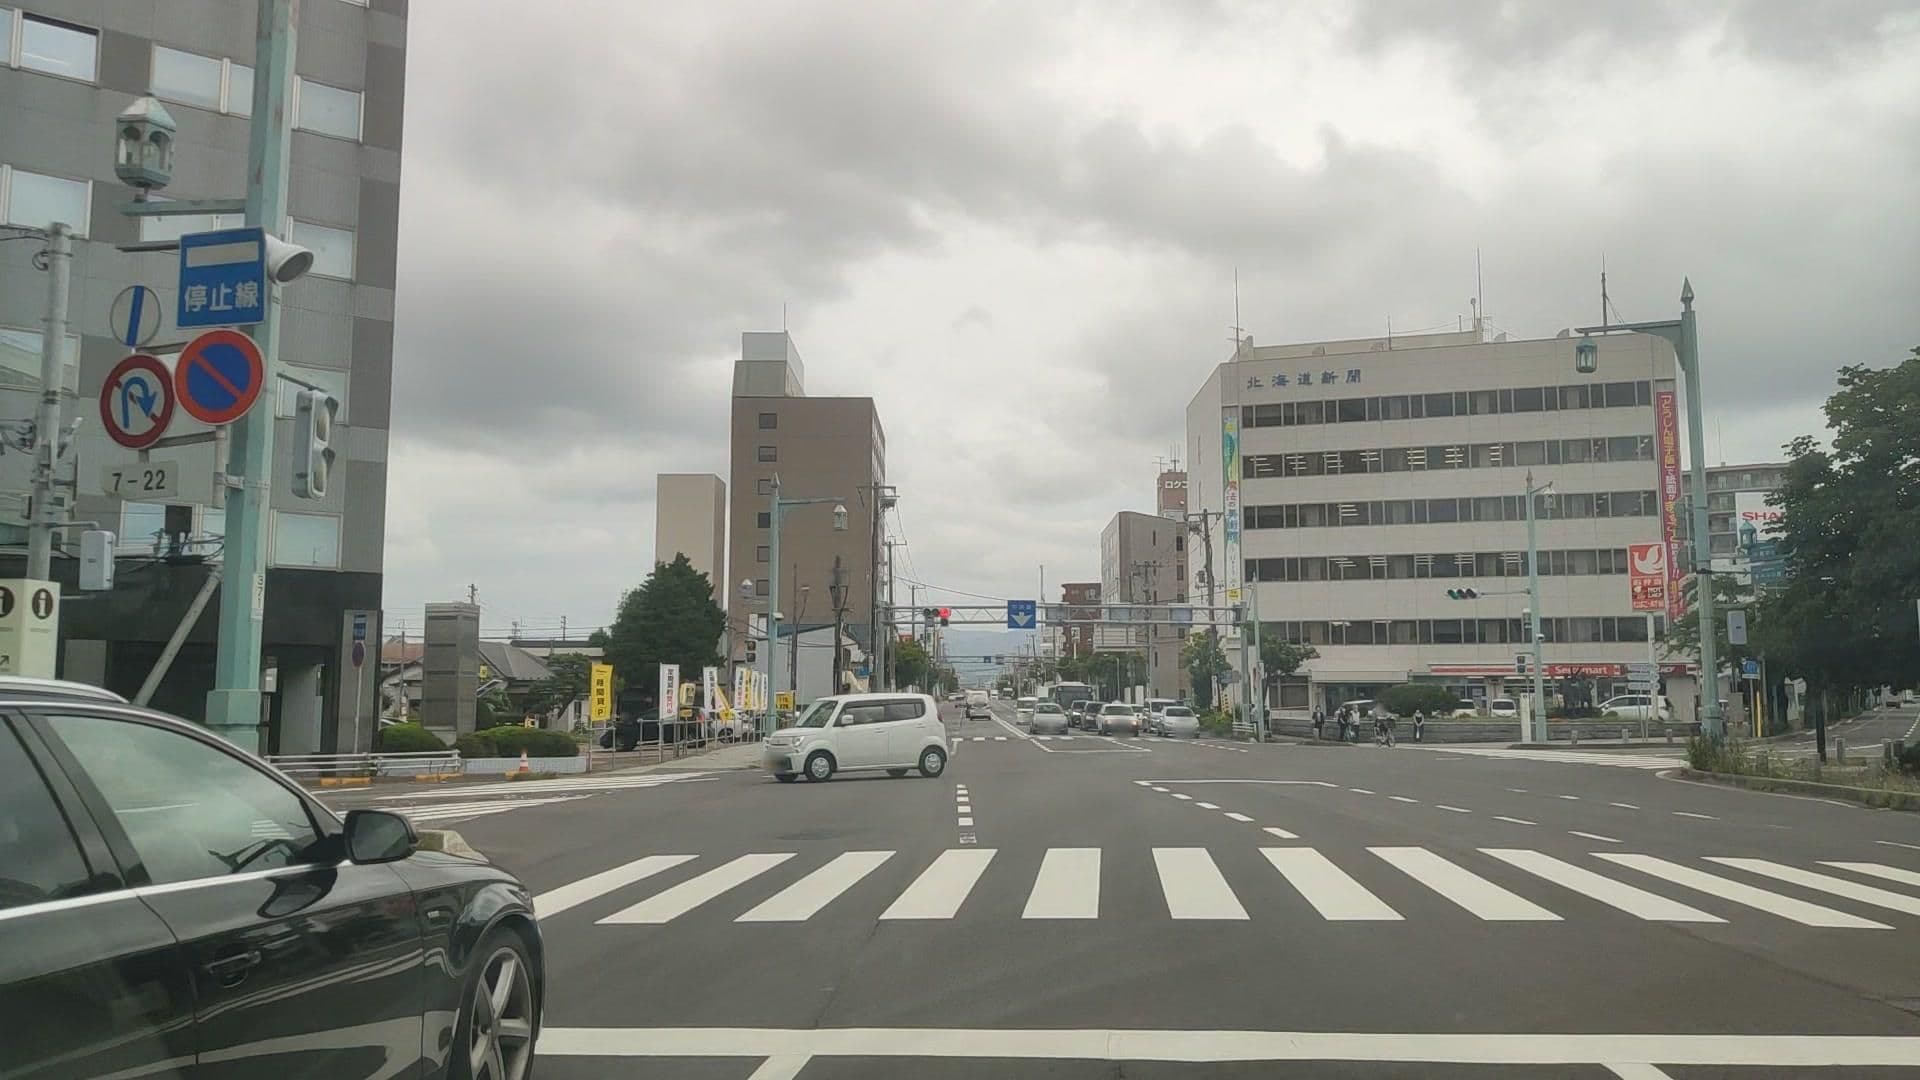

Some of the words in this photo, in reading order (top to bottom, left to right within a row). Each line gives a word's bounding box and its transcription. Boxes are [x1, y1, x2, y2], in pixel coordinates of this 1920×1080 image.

[184, 281, 258, 312] 停止線
[1246, 369, 1361, 390] 北海道新聞
[112, 469, 166, 492] 7-22
[1742, 511, 1783, 521] SHA
[1554, 665, 1608, 675] Seimart
